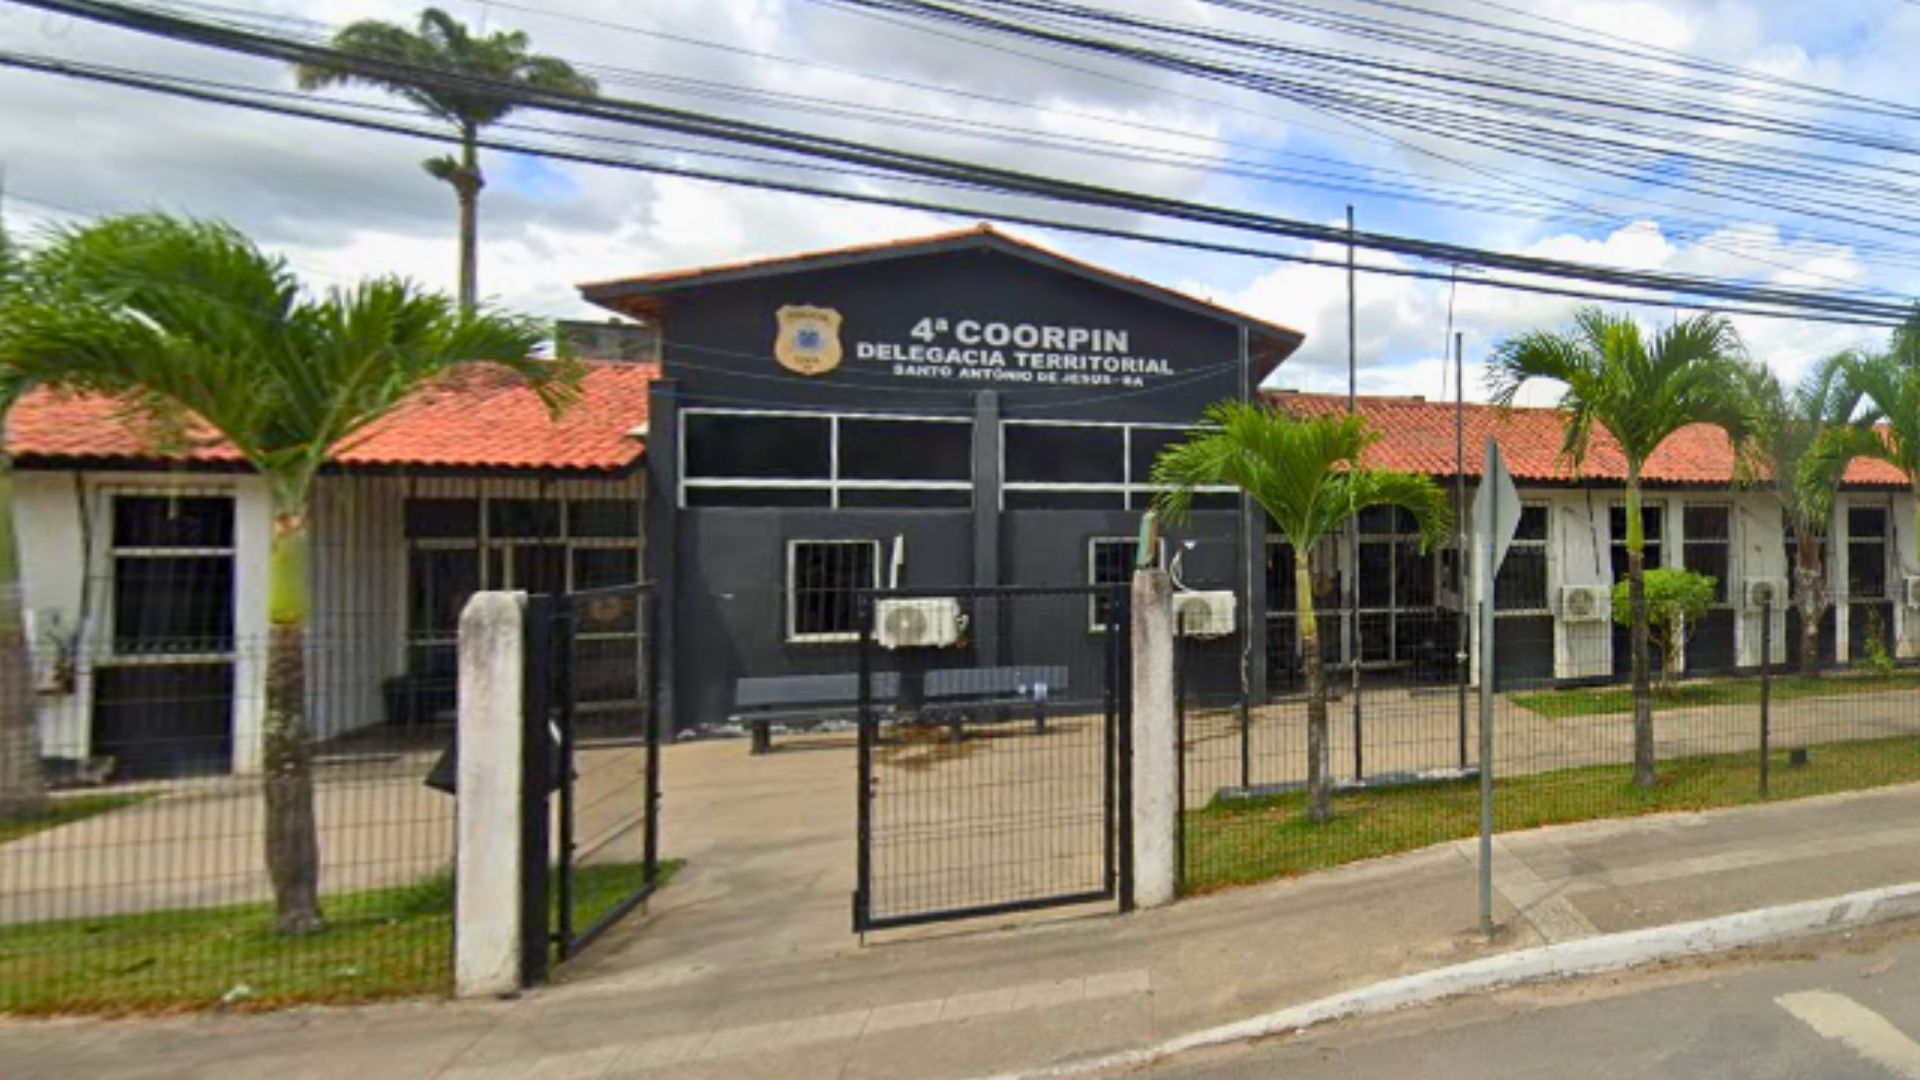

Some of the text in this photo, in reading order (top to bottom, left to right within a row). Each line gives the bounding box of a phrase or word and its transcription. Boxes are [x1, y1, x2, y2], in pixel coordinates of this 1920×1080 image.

[910, 317, 1129, 353] 4ª COORPIN
[856, 342, 1174, 376] DELEGACIA TERRITORIAL
[893, 364, 952, 377] SANTO
[1037, 372, 1057, 384] DE
